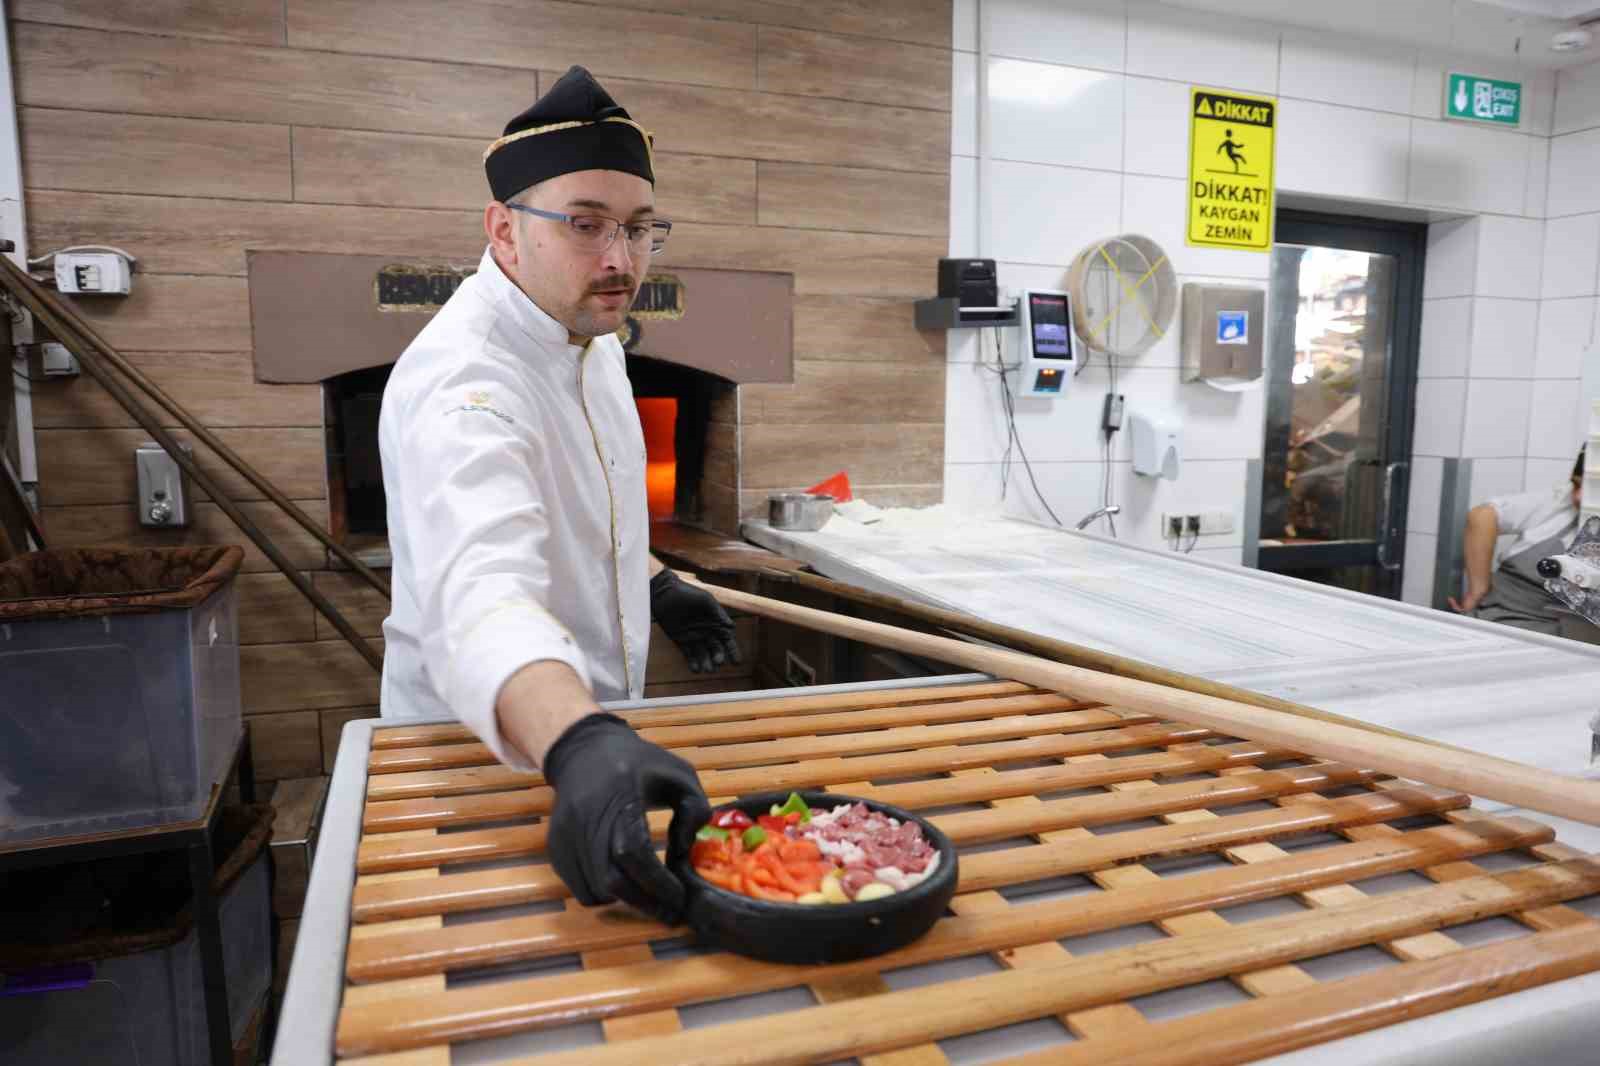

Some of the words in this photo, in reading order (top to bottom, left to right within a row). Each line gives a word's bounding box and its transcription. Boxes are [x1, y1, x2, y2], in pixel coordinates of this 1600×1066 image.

[1214, 100, 1270, 123] DİKKAT
[1493, 102, 1515, 117] EXIT
[1194, 179, 1268, 206] DİKKAT!
[1199, 204, 1260, 223] KAYGAN
[1205, 223, 1253, 240] ZEMİN
